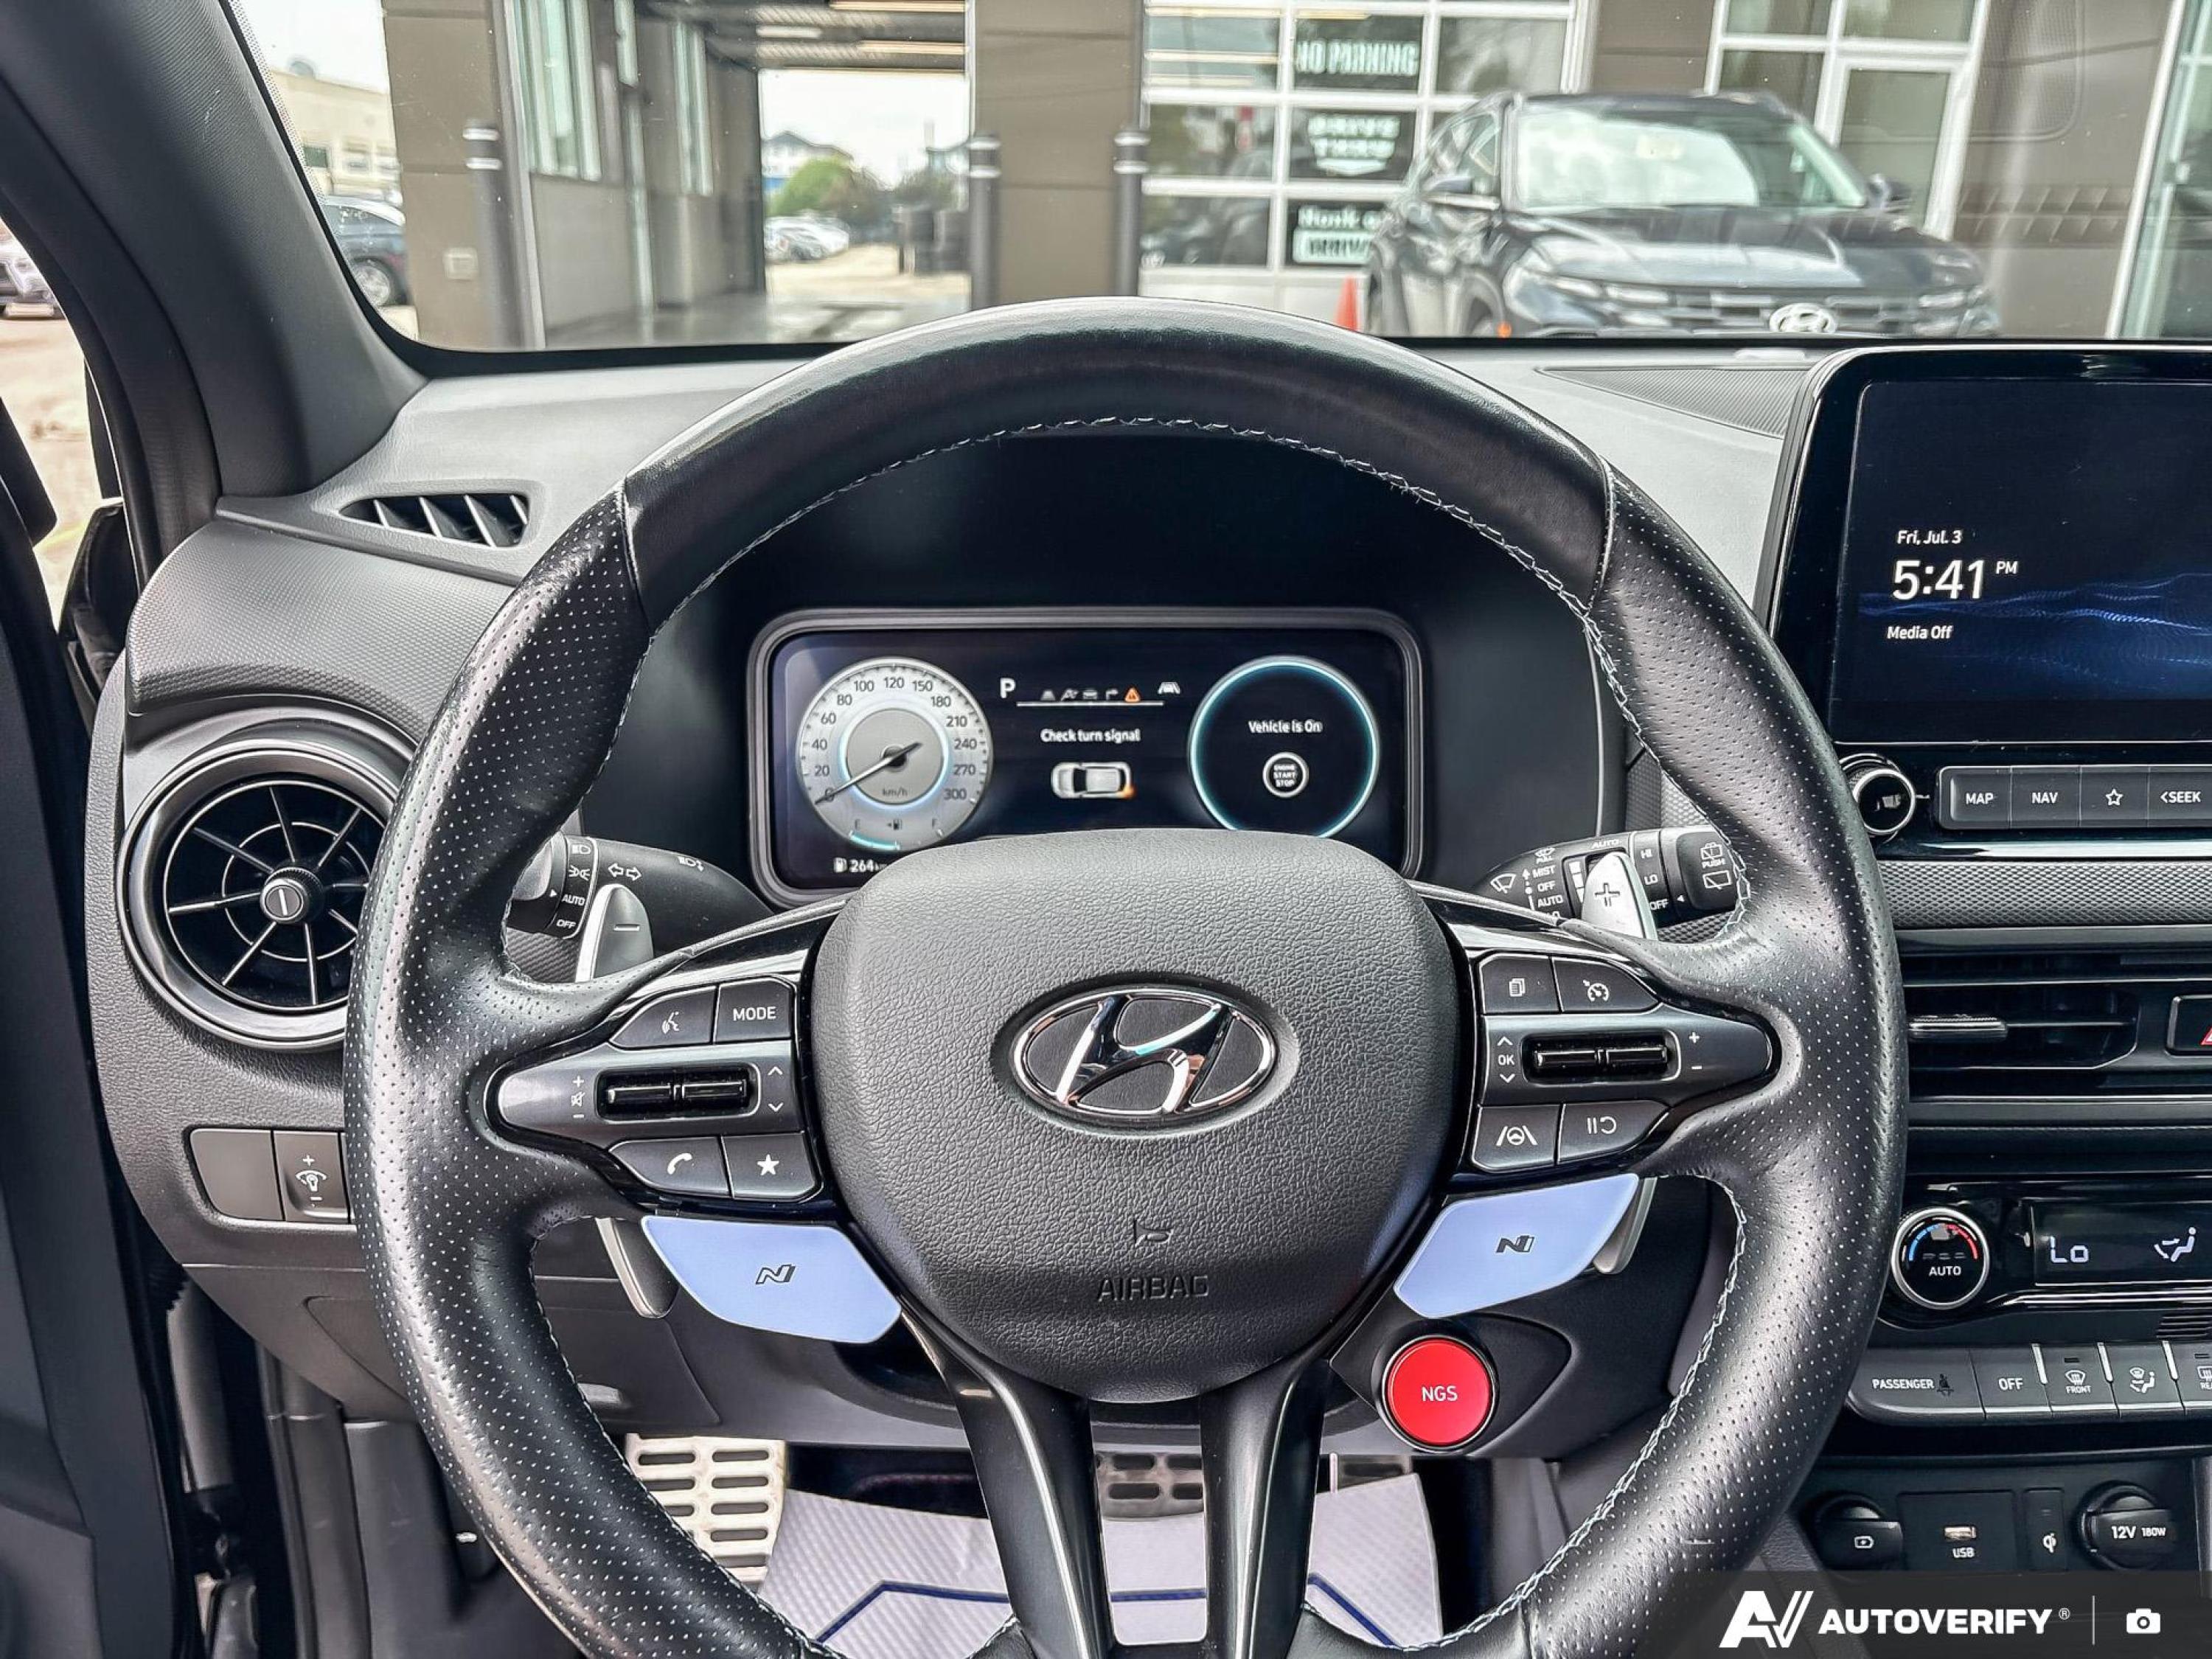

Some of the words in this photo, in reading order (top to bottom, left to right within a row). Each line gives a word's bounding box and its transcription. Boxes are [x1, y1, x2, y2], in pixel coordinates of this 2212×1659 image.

[1897, 529, 1921, 546] Fri,
[1923, 529, 1951, 545] Jul.
[1952, 529, 1962, 544] 3
[1892, 560, 1985, 600] 5:41
[1995, 561, 2019, 574] PM
[1887, 626, 1930, 639] Media
[1932, 625, 1953, 639] Off
[854, 681, 874, 692] 100
[884, 678, 905, 689] 120
[912, 681, 933, 692] 150
[1000, 677, 1017, 699] P
[837, 695, 852, 706] 80
[931, 696, 951, 707] 180
[821, 713, 836, 724] 60
[946, 716, 967, 727] 210
[1248, 720, 1290, 734] Vehicle
[1292, 720, 1303, 734] is
[1304, 720, 1323, 734] On
[1040, 728, 1077, 742] Check
[1077, 729, 1103, 742] turn
[1104, 728, 1142, 744] signal
[812, 739, 827, 750] 40
[954, 739, 977, 750] 240
[815, 765, 830, 776] 20
[954, 765, 975, 776] 270
[882, 787, 908, 797] km/h
[944, 789, 966, 800] 300
[2031, 792, 2059, 804] NAV
[1966, 793, 1994, 805] MAP
[1640, 849, 1652, 859] HI
[849, 858, 874, 873] 264
[1701, 858, 1725, 869] PUSH
[1532, 865, 1556, 878] MIST
[1537, 880, 1556, 892] OFF
[1644, 874, 1658, 886] LO
[561, 894, 585, 907] AUTO
[1537, 894, 1563, 908] AUTO
[1649, 898, 1669, 911] OFF
[556, 919, 577, 930] OFF
[733, 1006, 777, 1022] MODE
[1498, 1054, 1515, 1066] OK
[1929, 1265, 1962, 1277] AUTO
[1098, 1275, 1209, 1302] AIRBAG
[1872, 1377, 1935, 1390] PASSENGER
[1998, 1377, 2024, 1391] OFF
[2066, 1385, 2092, 1394] FRONT
[1422, 1385, 1458, 1402] NGS
[2111, 1525, 2137, 1540] 12V
[2141, 1526, 2166, 1538] 180W
[1952, 1548, 1975, 1559] USB
